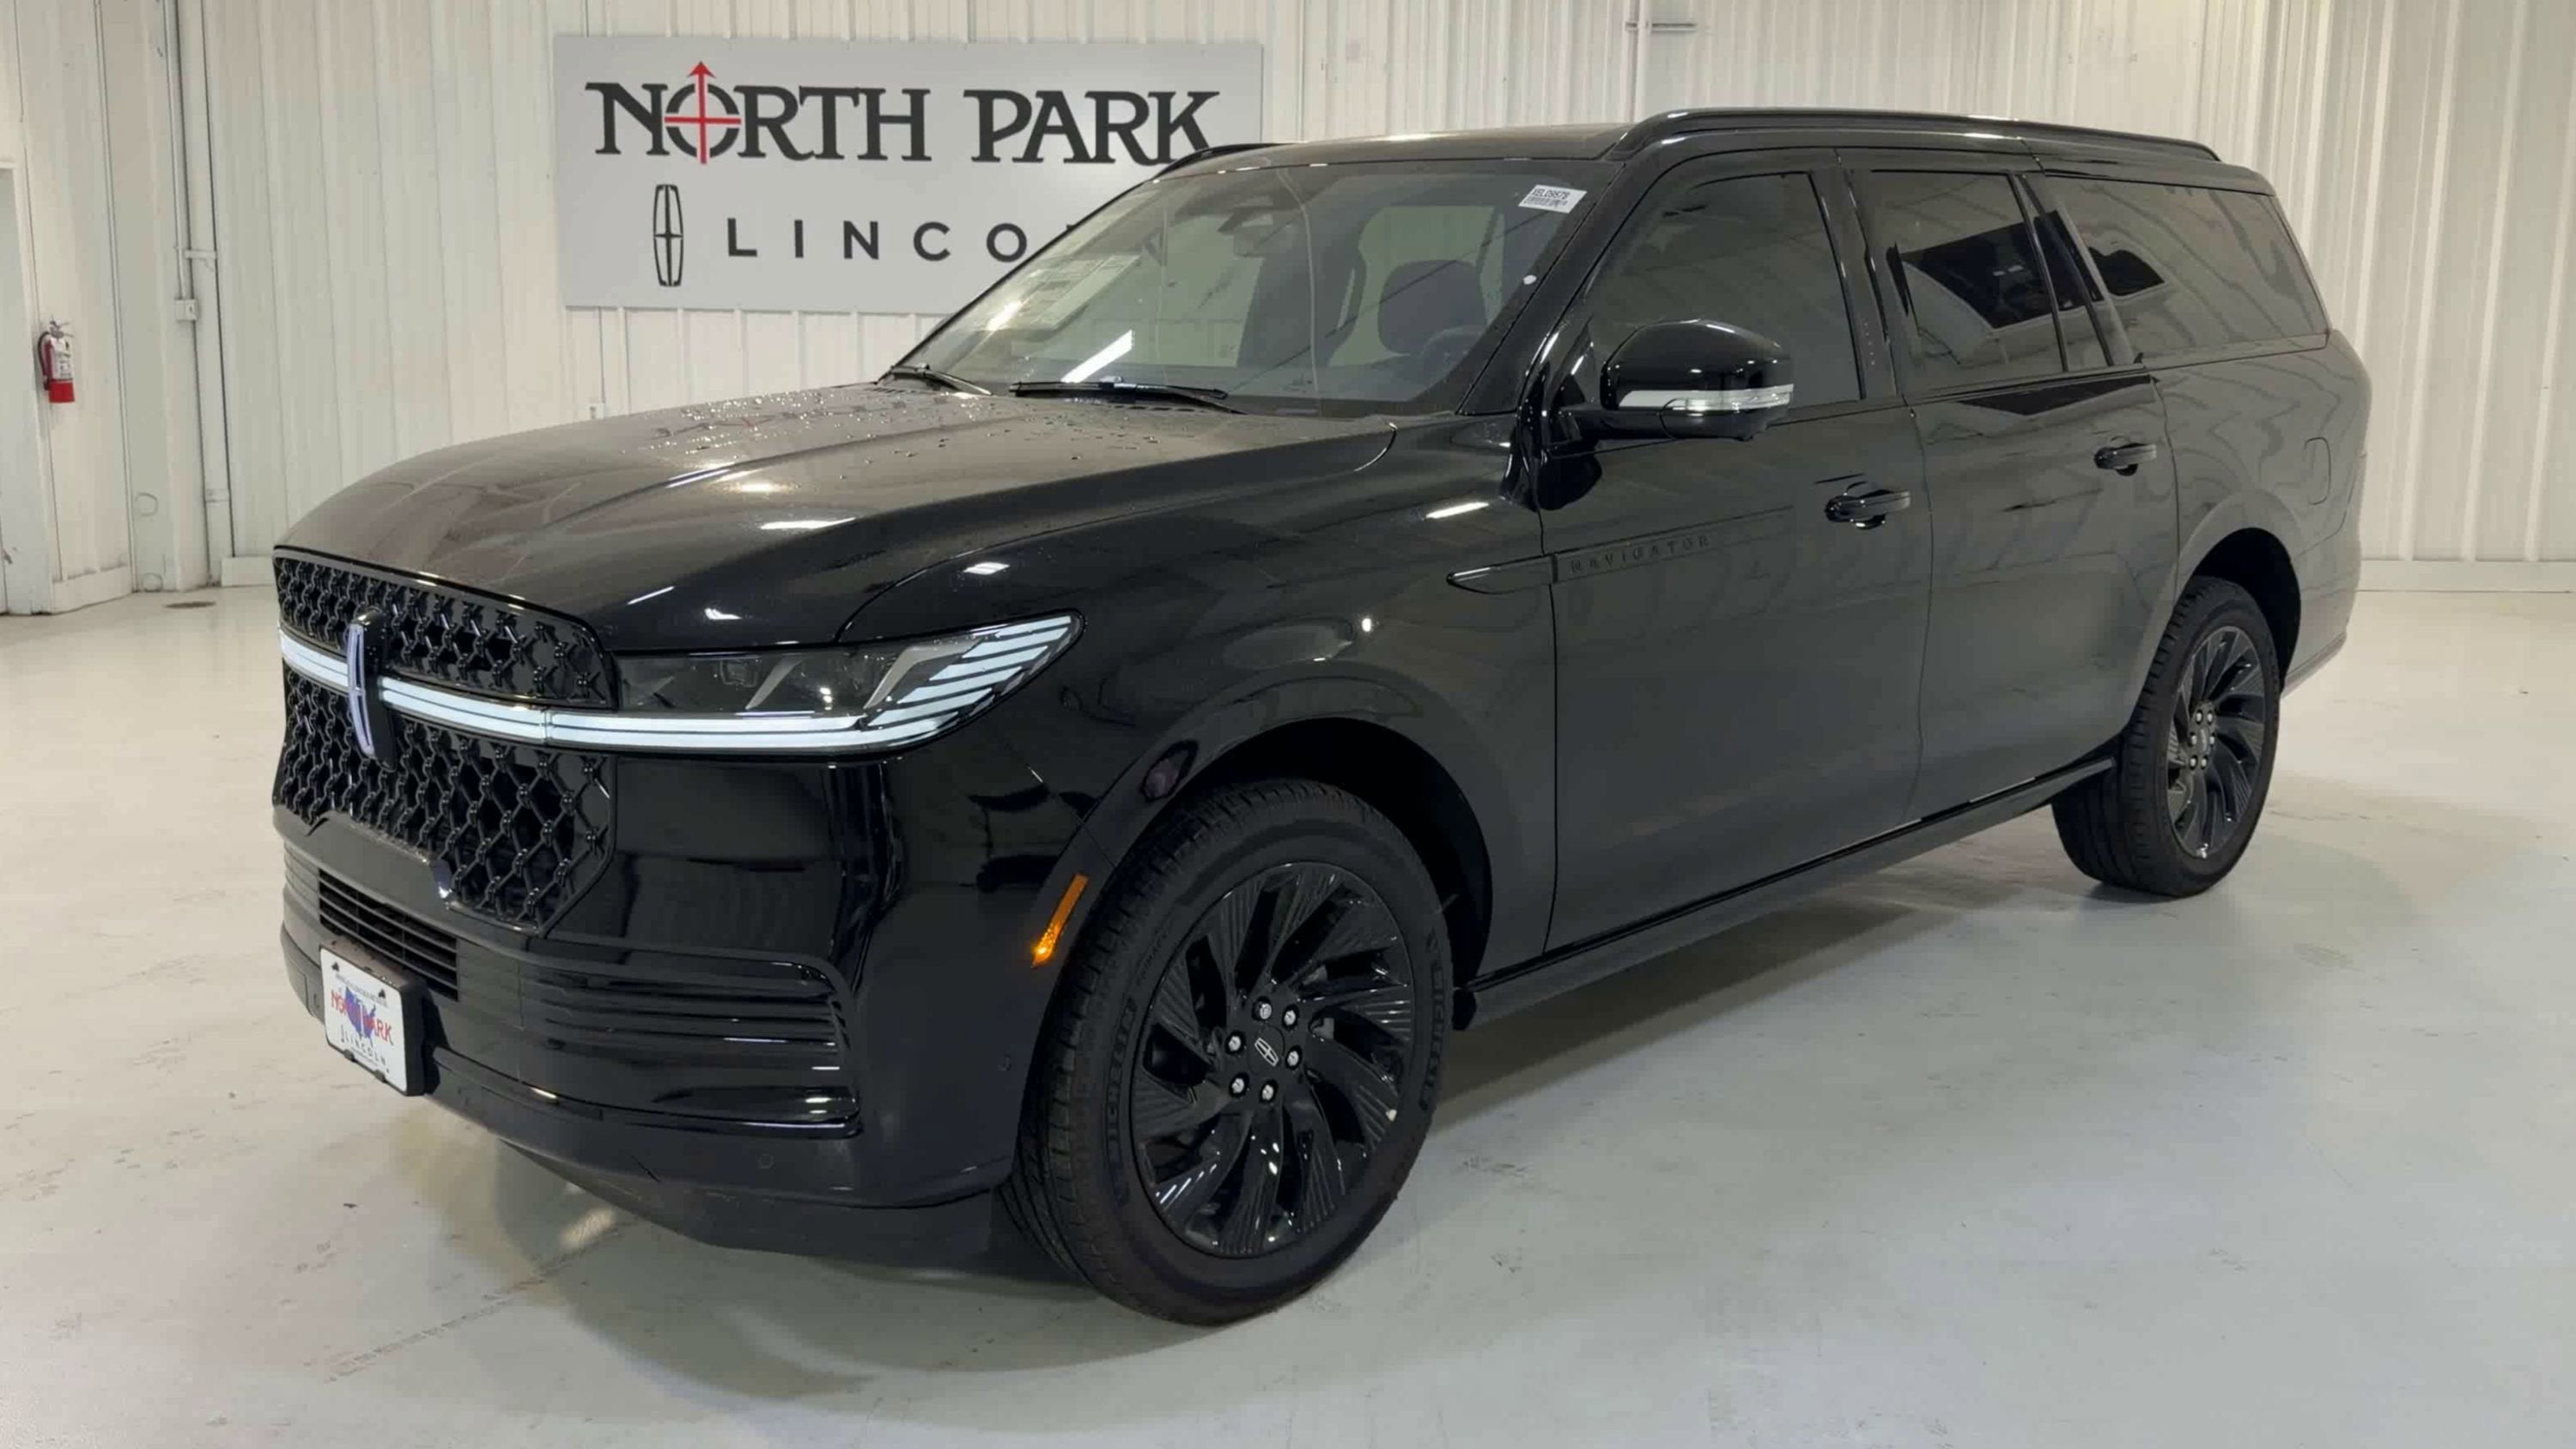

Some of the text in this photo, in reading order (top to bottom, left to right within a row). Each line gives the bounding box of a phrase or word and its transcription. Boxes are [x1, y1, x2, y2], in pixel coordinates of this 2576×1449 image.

[585, 80, 1220, 165] NORTH PARK
[726, 217, 1075, 262] LINCO
[1571, 535, 1709, 573] NAVIGATOR
[1419, 965, 1444, 1108] MICHELIN
[1105, 1002, 1136, 1167] MICHELIN
